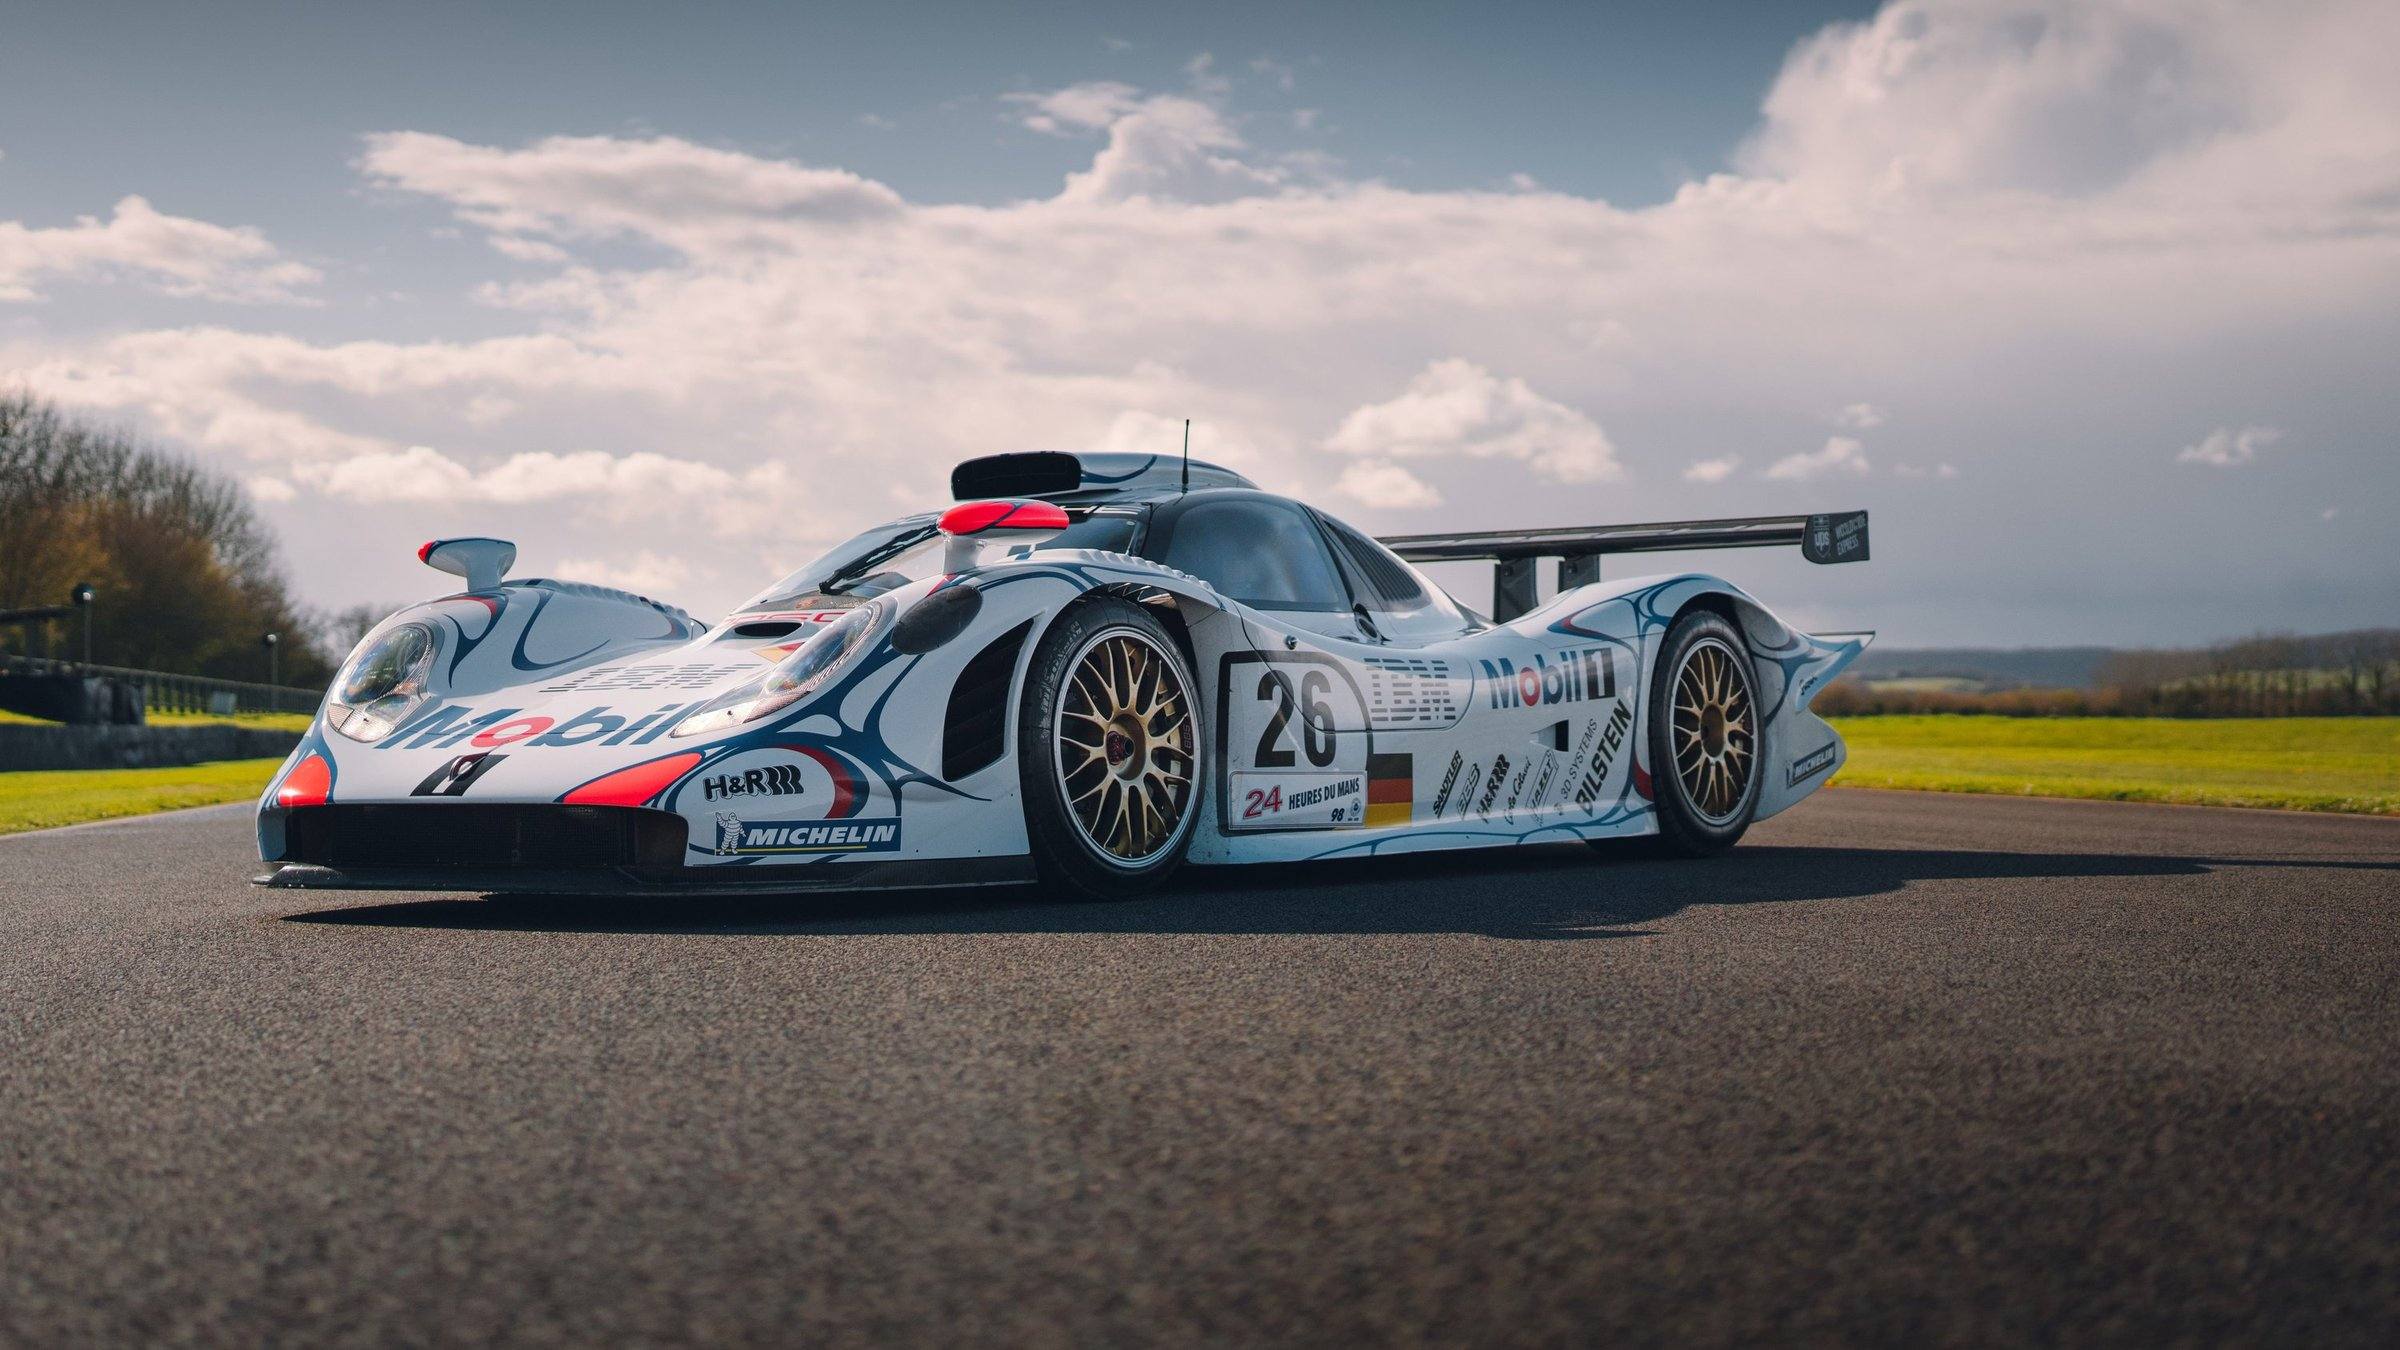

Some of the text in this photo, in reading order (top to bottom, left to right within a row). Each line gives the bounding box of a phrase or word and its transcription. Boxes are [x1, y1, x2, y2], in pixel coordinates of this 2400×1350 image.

[538, 664, 762, 692] IBM
[1364, 658, 1456, 722] IBM
[1479, 650, 1582, 709] Mobil
[373, 699, 712, 749] Mobil
[1255, 670, 1337, 768] 26
[1433, 750, 1462, 817] SANDTLER
[1561, 718, 1598, 800] 3D SYSTEMS
[1575, 698, 1632, 817] BILSTEIN
[1794, 747, 1834, 778] MICHELIN
[703, 768, 769, 802] H&R
[1243, 778, 1360, 820] 24 HEURES DU MANS
[1457, 763, 1480, 818] BBS
[745, 825, 897, 846] MICHELIN
[1331, 808, 1345, 821] 98
